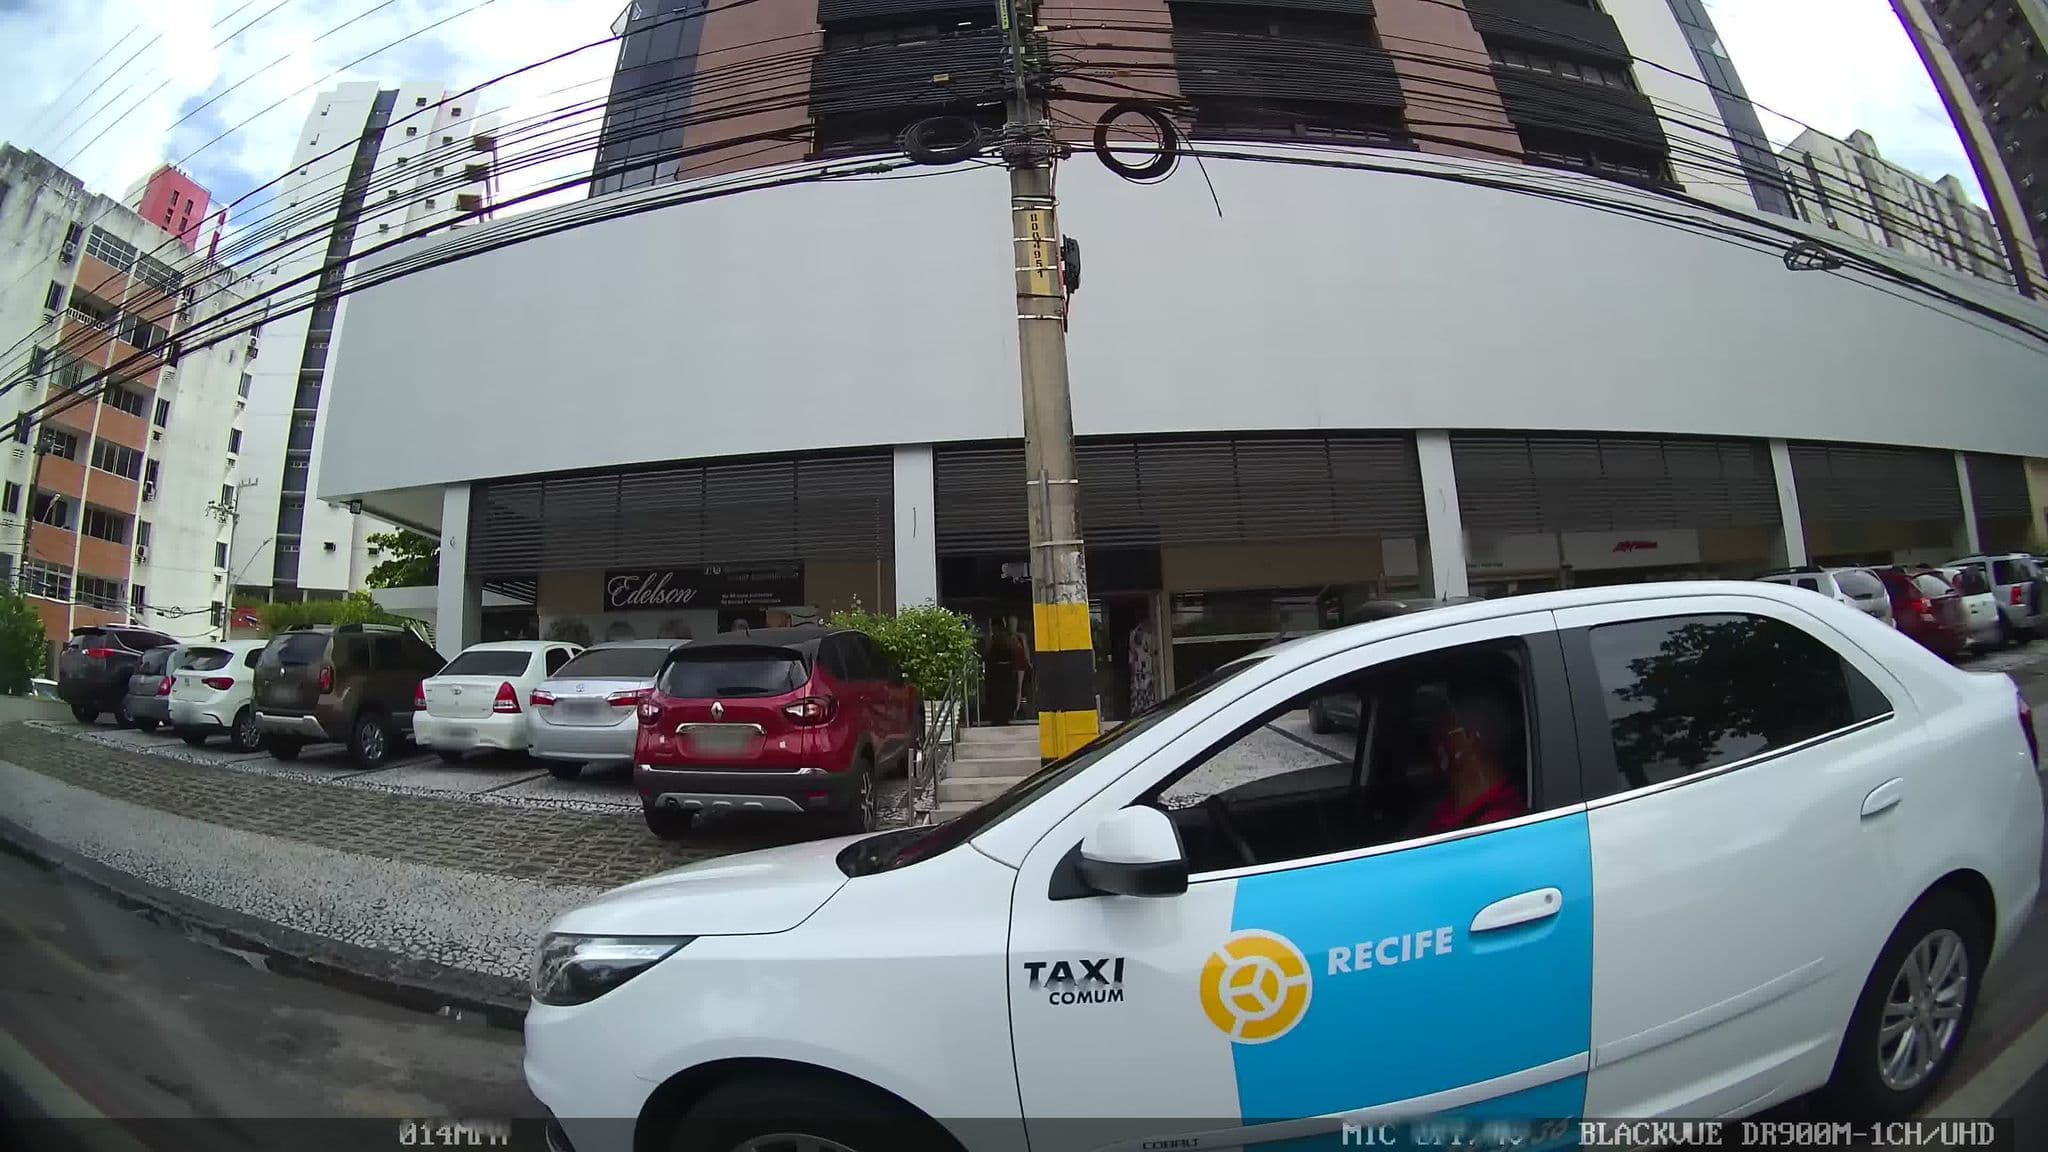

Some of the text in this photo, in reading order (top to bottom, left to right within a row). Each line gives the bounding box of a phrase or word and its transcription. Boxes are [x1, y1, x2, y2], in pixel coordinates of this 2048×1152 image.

[607, 572, 697, 607] Edelson
[1327, 926, 1453, 976] RECIFE
[1023, 957, 1125, 989] TAXI
[1049, 989, 1124, 1005] COMUM
